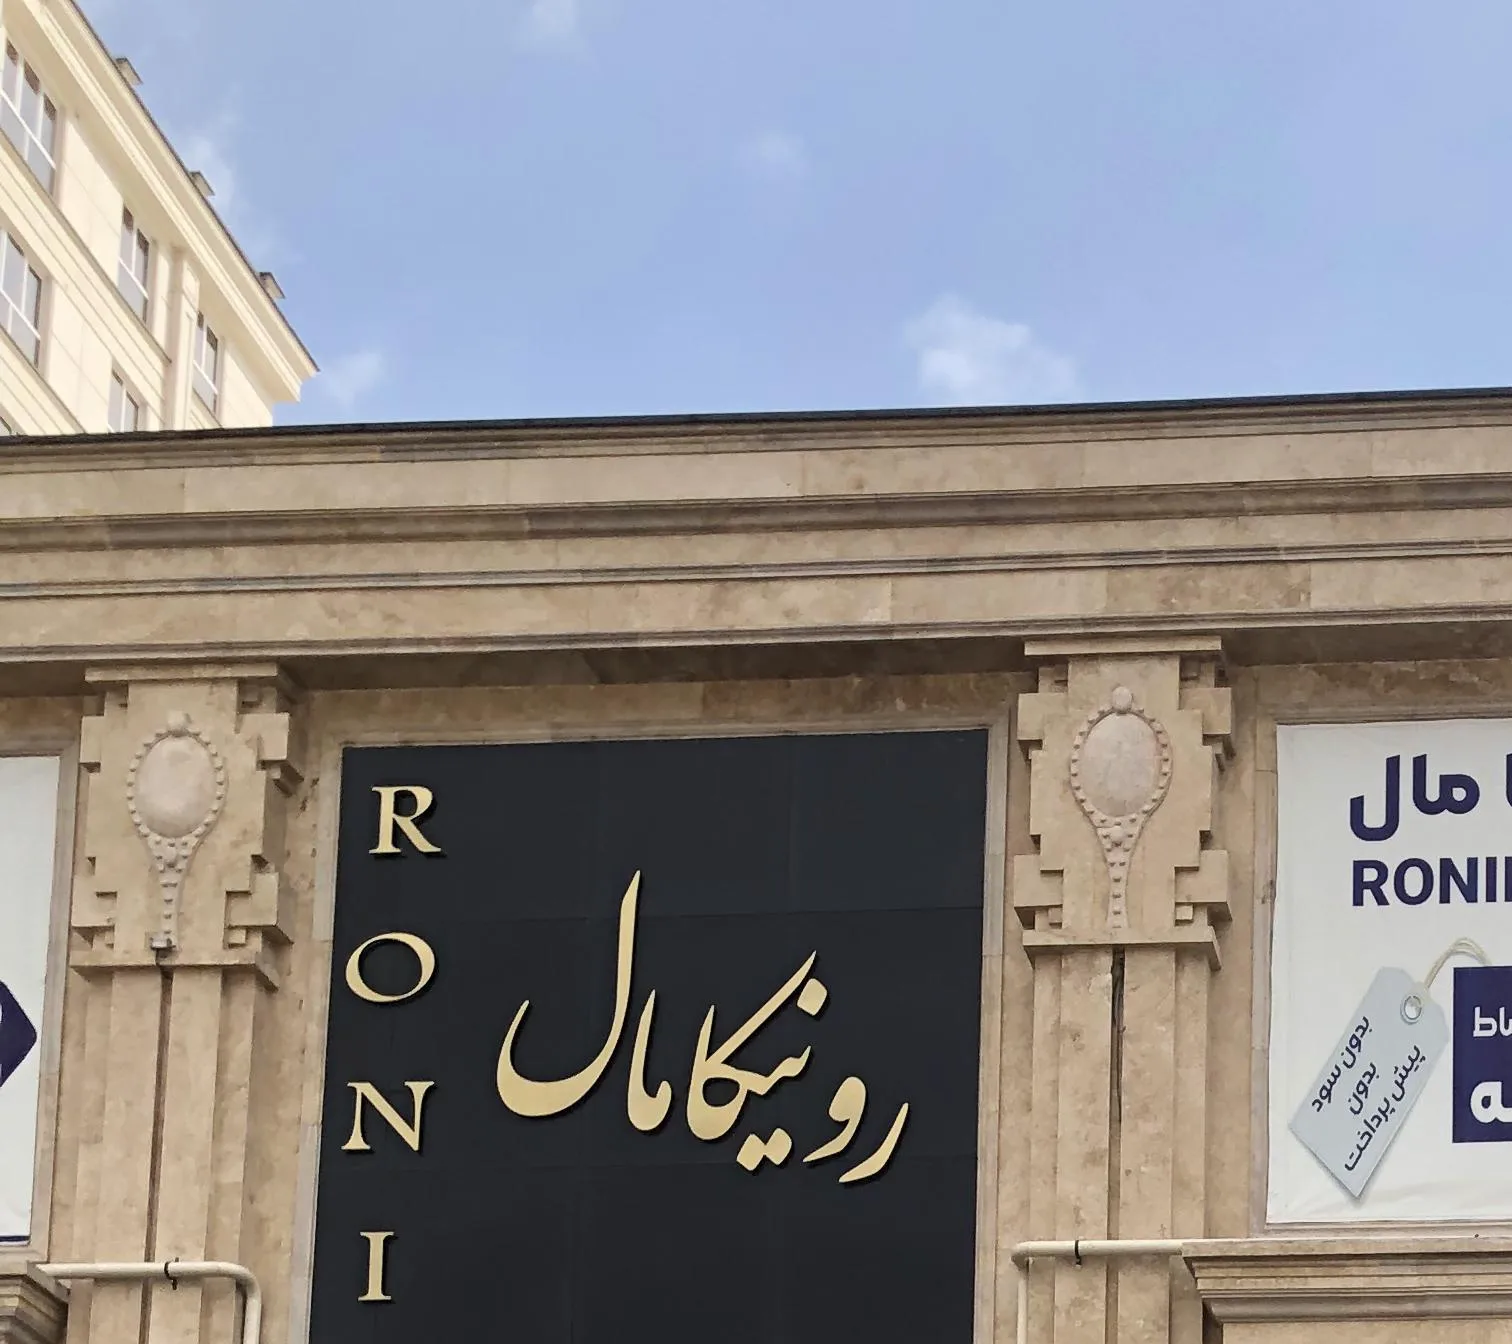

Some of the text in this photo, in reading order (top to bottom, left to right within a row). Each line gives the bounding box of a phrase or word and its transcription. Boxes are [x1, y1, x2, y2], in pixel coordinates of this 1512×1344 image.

[1349, 752, 1481, 842] مال
[496, 869, 909, 1184] رونیکا مال
[1311, 1015, 1374, 1113] بدون سود
[1344, 1044, 1427, 1172] پیش پرداخت
[1347, 1061, 1380, 1116] بدون
